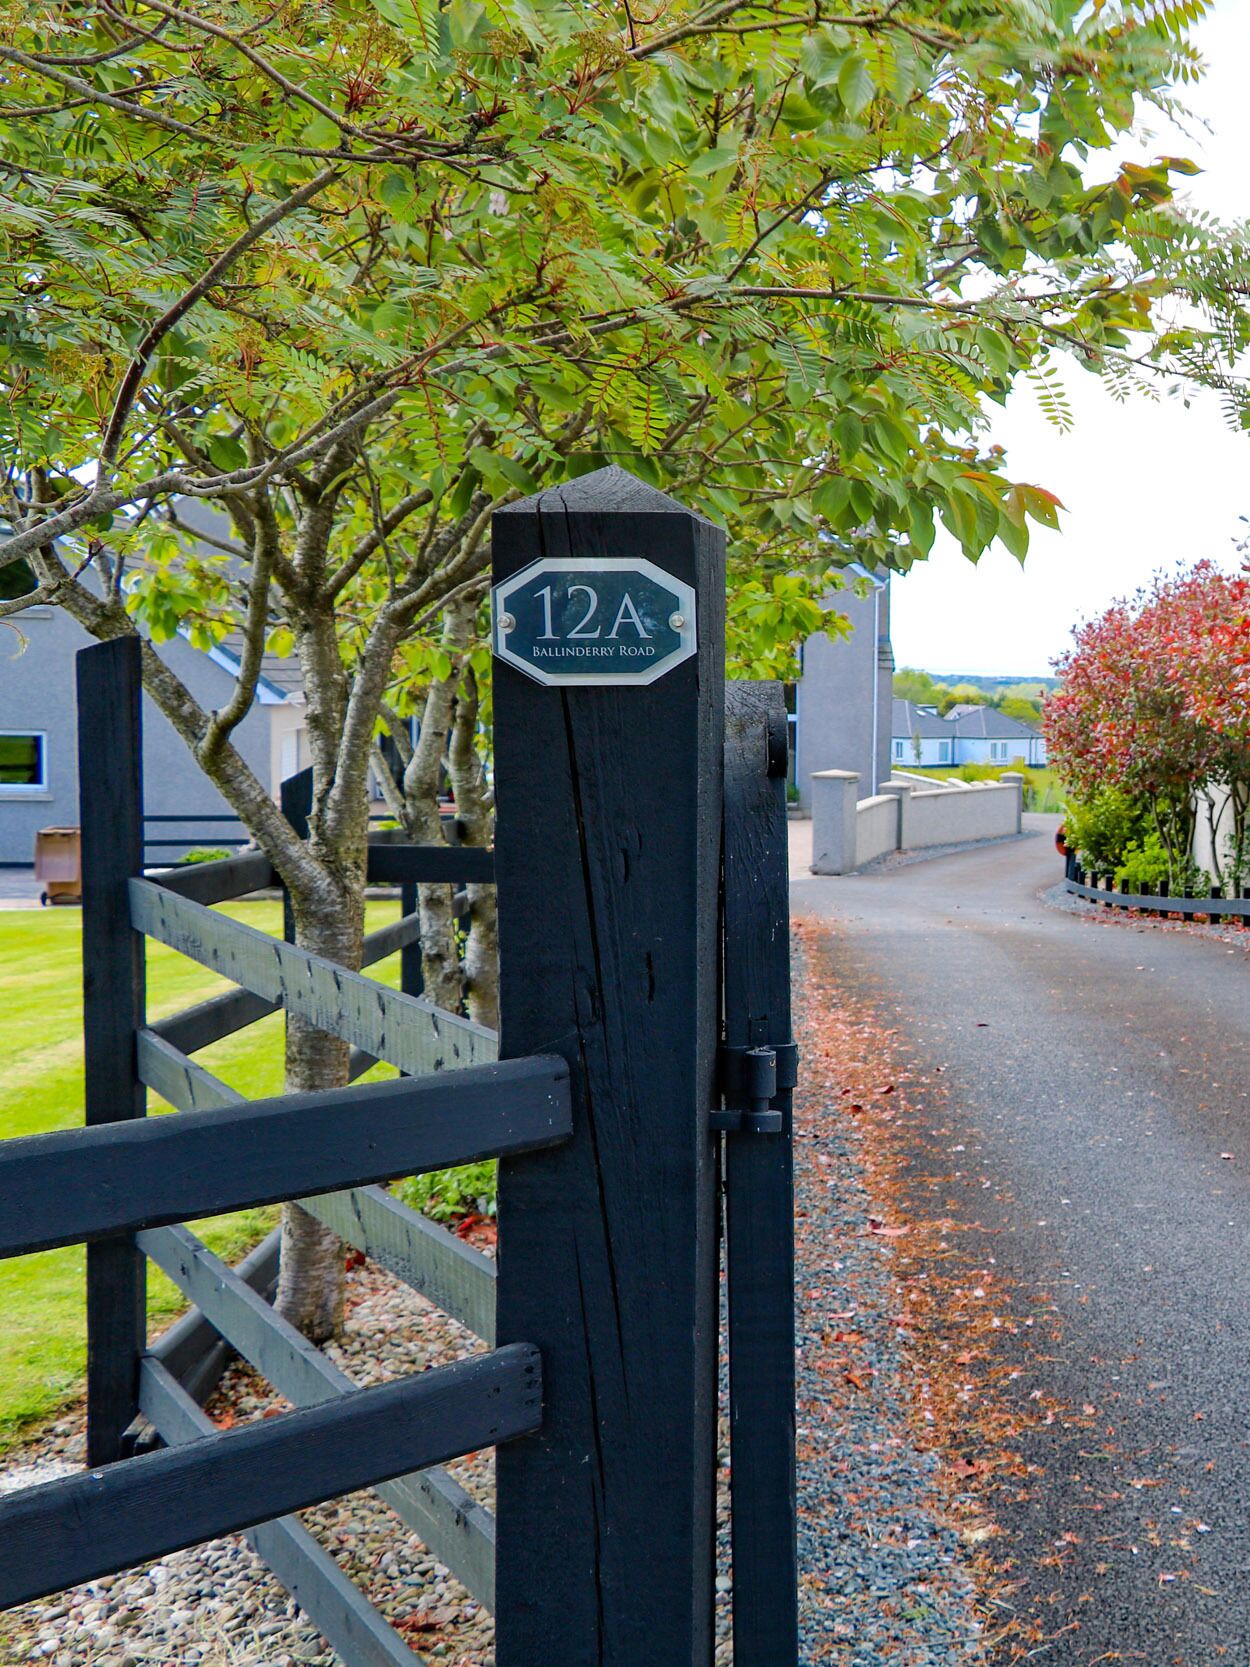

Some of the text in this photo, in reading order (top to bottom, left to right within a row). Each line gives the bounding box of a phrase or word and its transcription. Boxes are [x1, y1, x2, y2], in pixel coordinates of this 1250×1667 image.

[533, 585, 653, 639] 12A
[533, 645, 655, 657] BALLINDERRY ROAD
